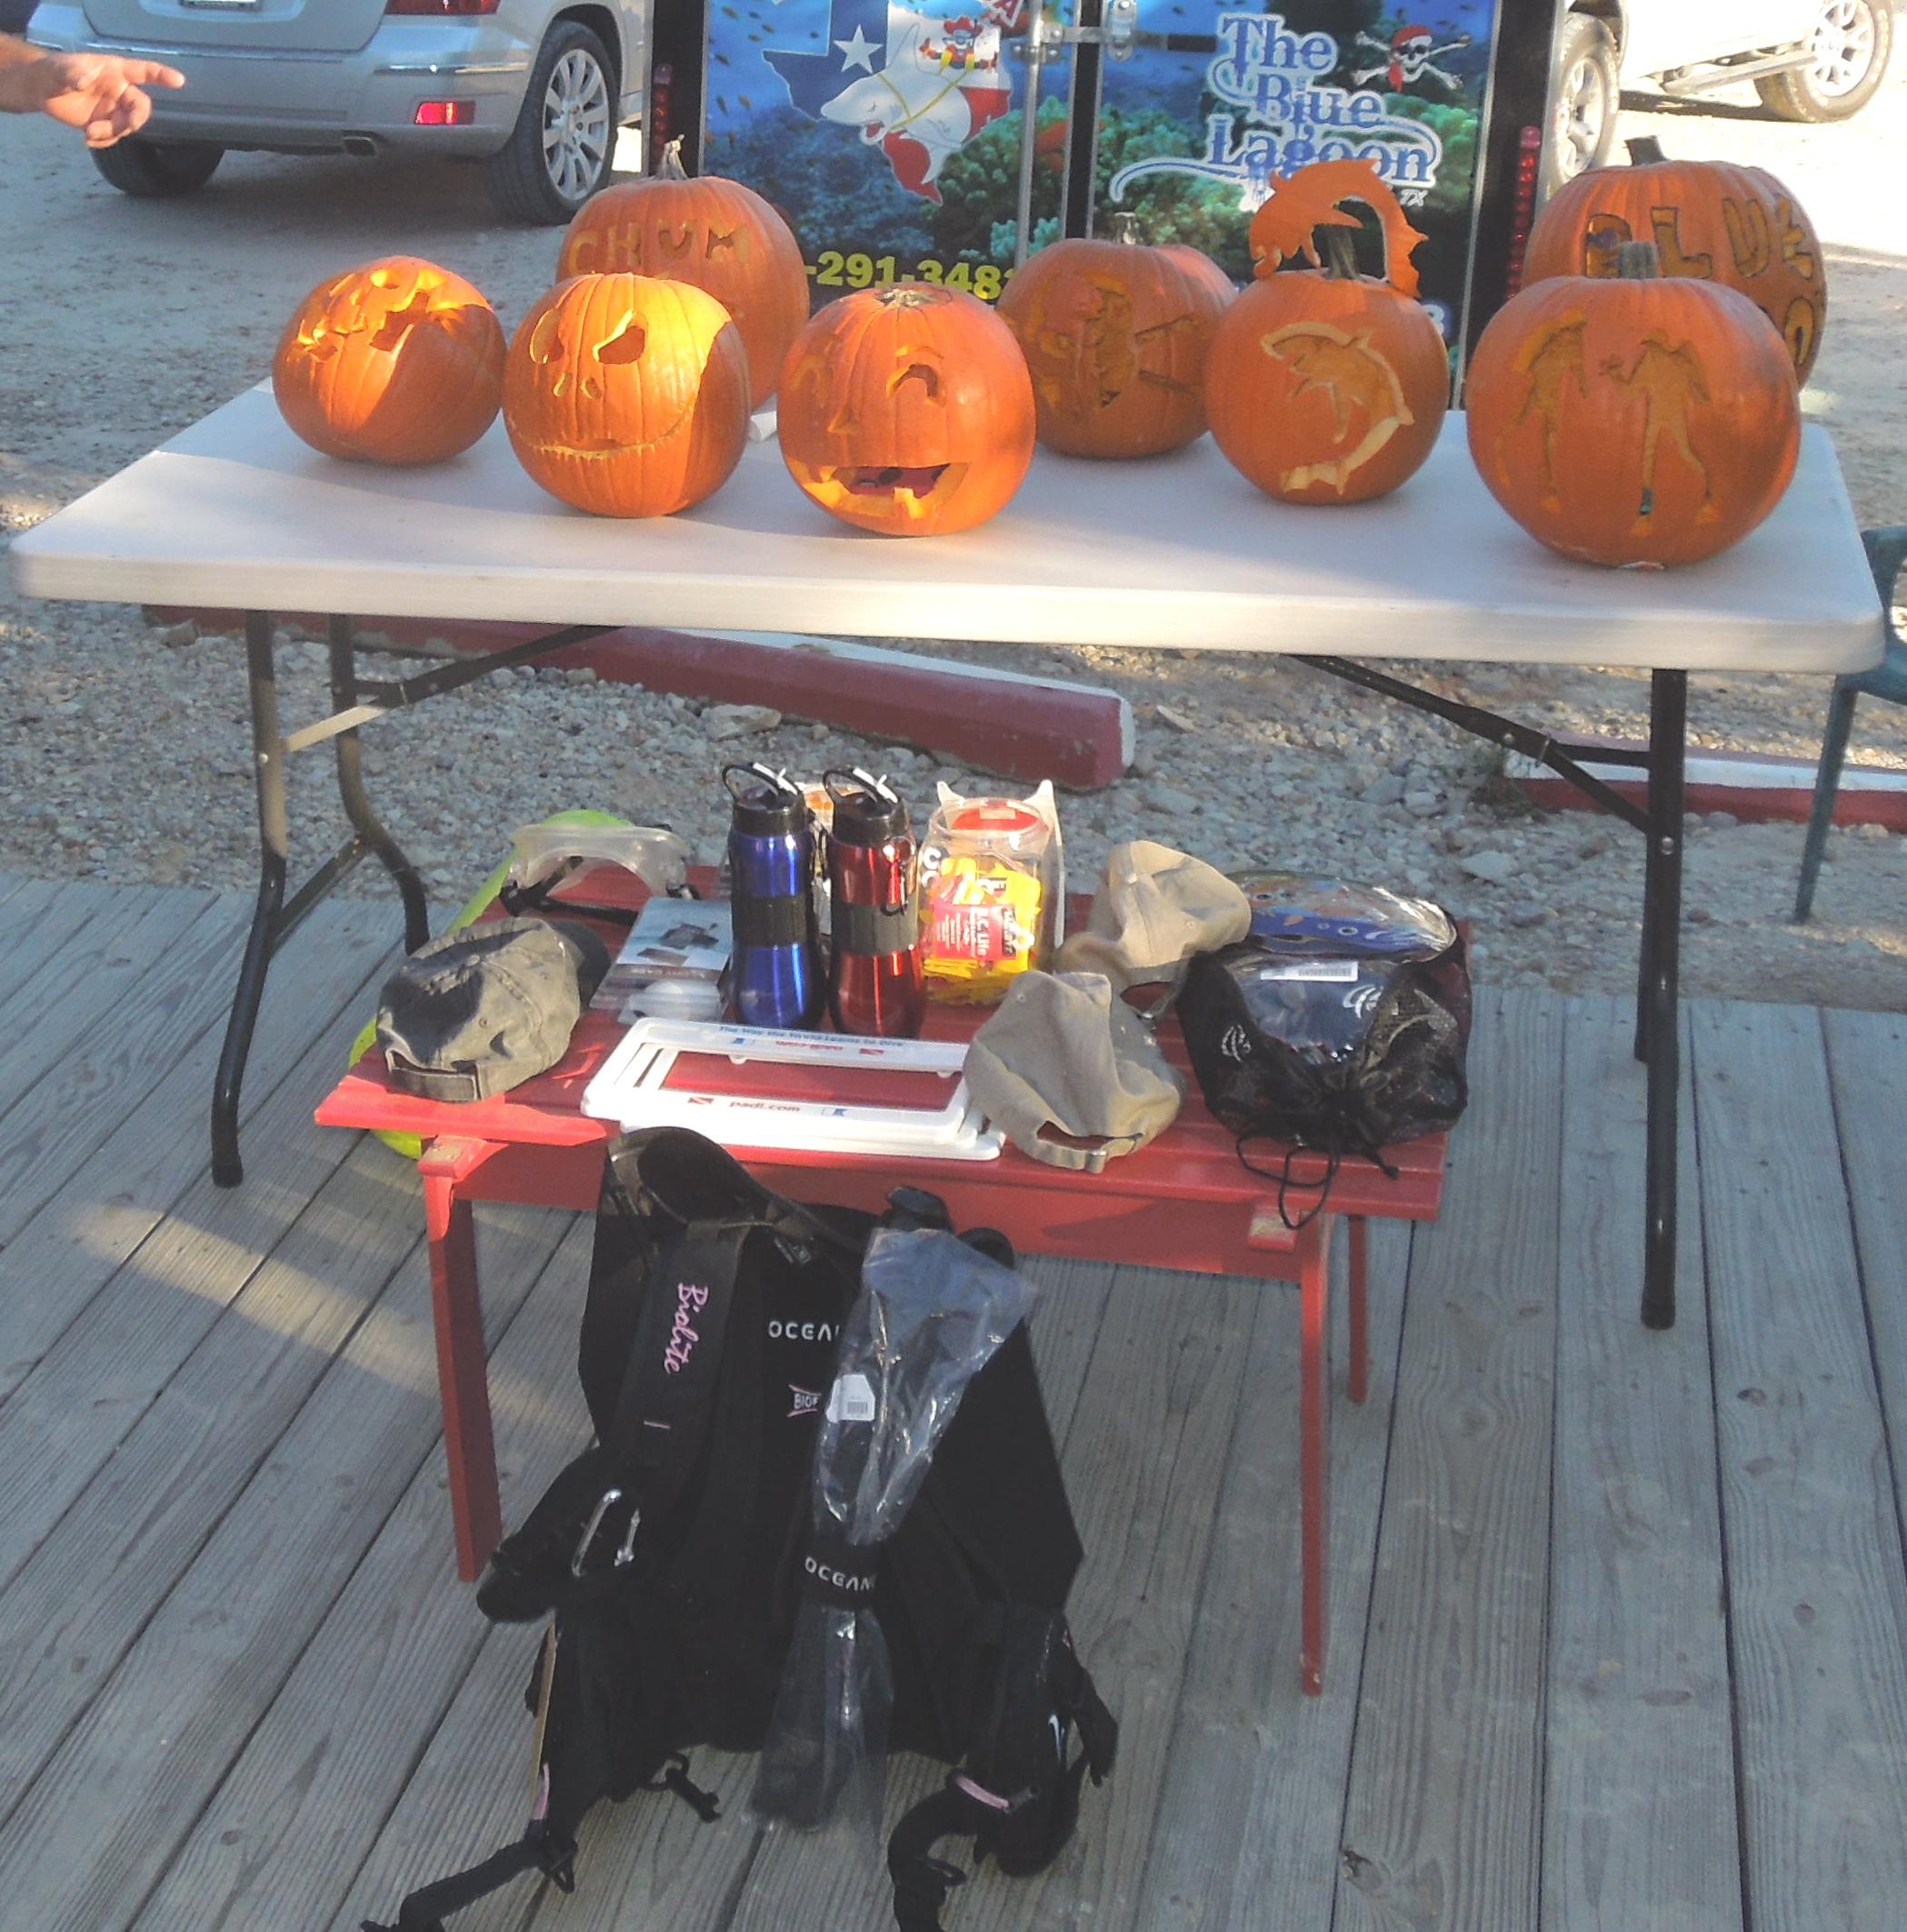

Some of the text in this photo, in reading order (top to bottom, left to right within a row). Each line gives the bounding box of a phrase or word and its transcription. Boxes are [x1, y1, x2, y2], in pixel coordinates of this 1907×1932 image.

[1218, 16, 1333, 89] The
[1208, 117, 1431, 183] Lagoon
[1400, 189, 1429, 207] TX
[568, 217, 751, 275] CHUM
[729, 1100, 801, 1113] padi.com
[663, 1282, 709, 1376] Biolite
[767, 1320, 840, 1342] OCEA
